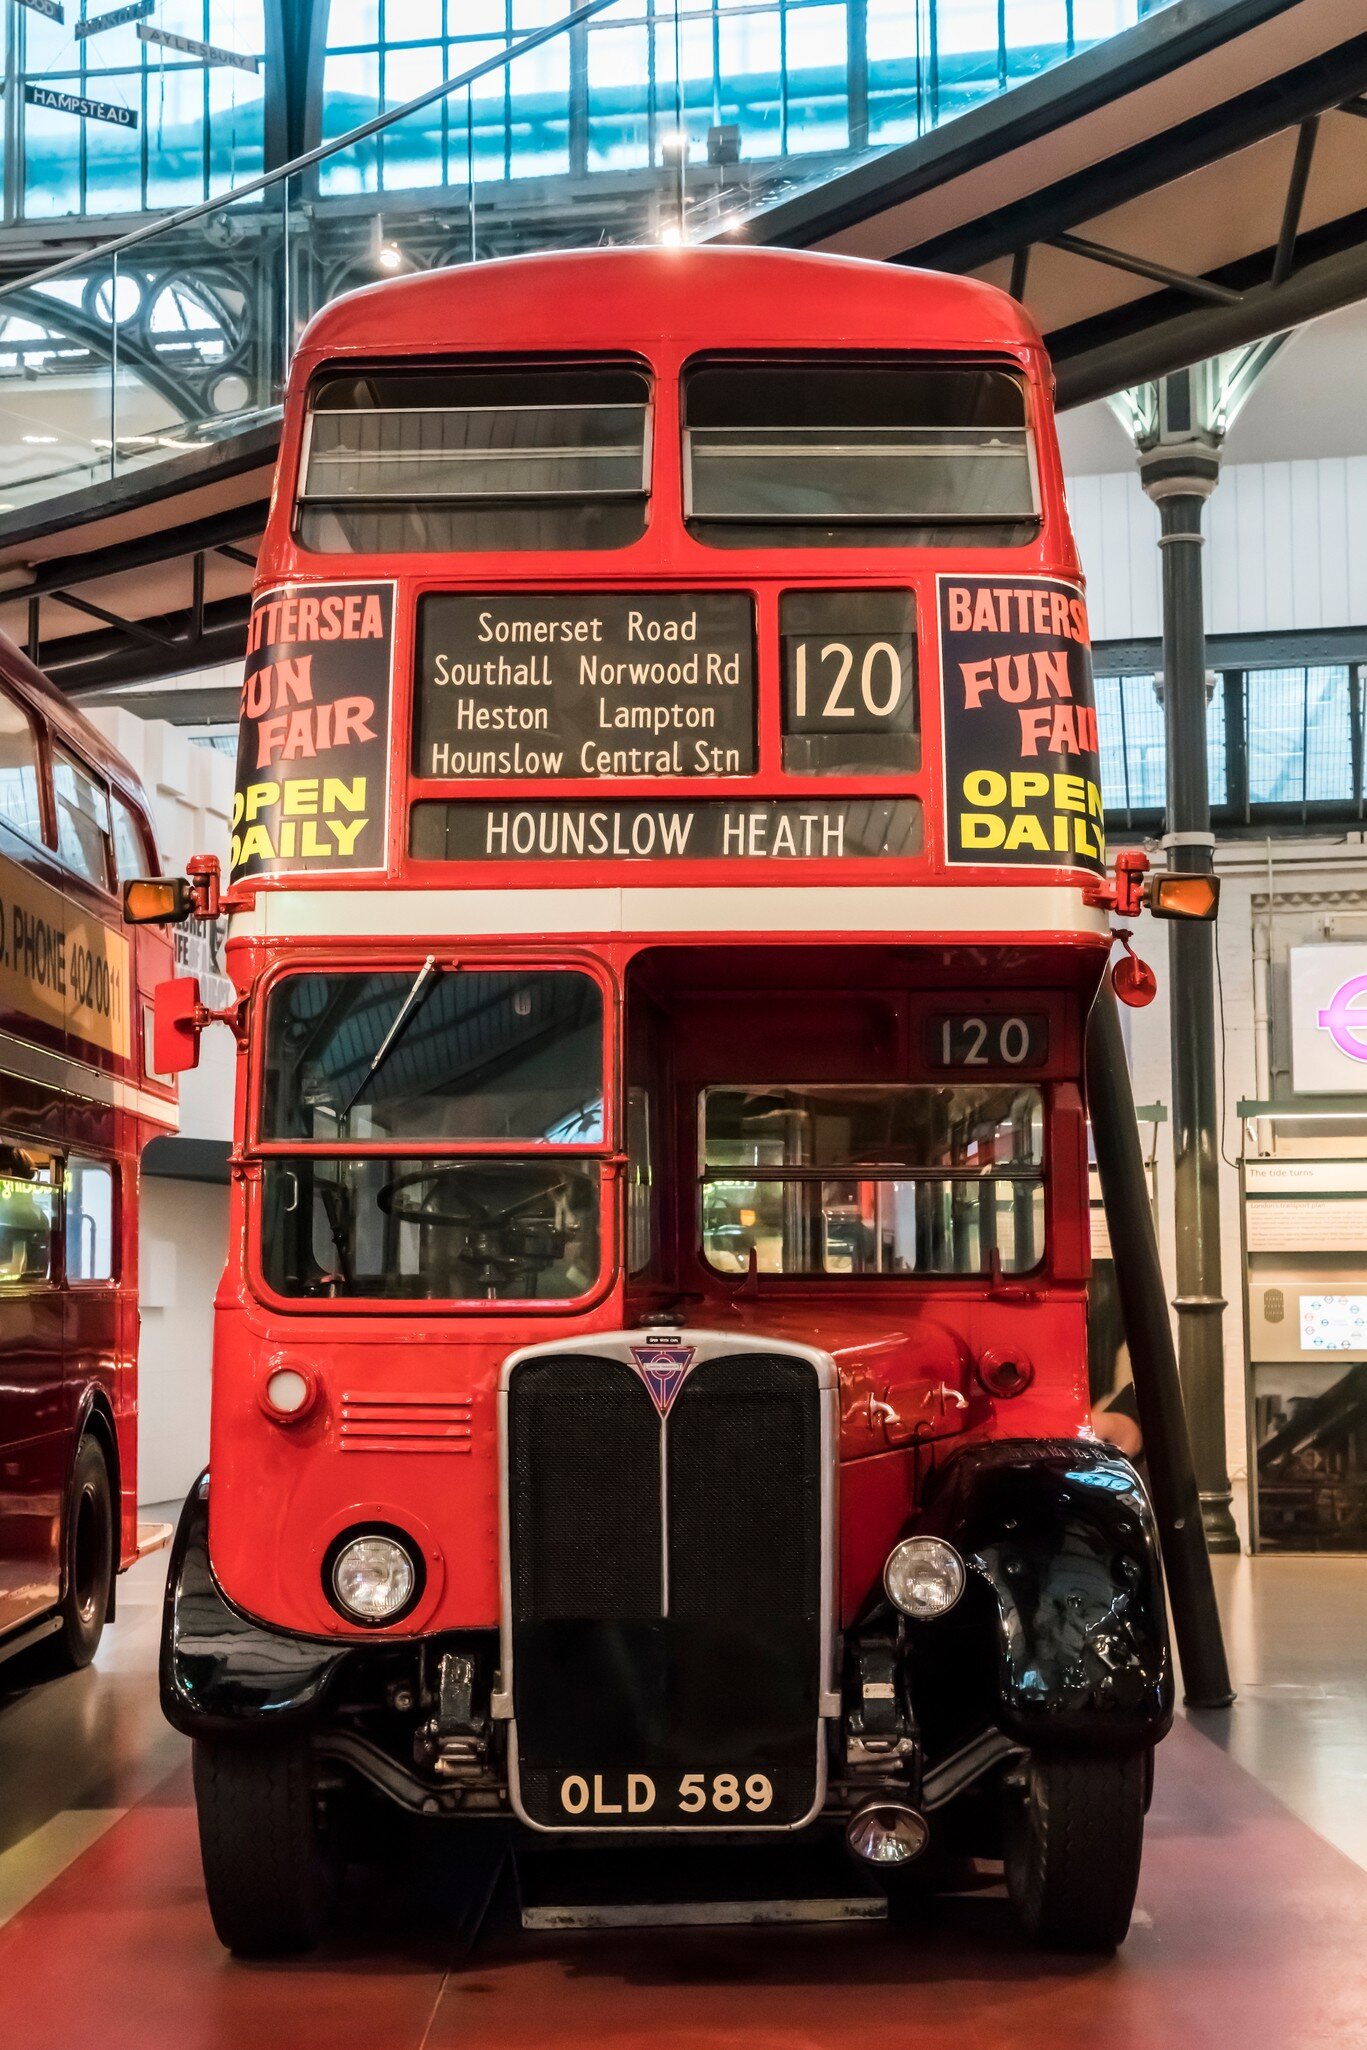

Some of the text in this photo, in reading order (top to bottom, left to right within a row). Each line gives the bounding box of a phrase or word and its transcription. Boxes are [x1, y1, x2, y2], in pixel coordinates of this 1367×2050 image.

[150, 30, 246, 68] AYLESBURY
[33, 88, 131, 125] HAMPSTEAD
[246, 594, 384, 656] TTERSEA
[477, 611, 697, 643] Somerset Road
[948, 587, 1091, 646] BATTERS
[434, 652, 740, 686] Southall Norwood Rd
[796, 641, 902, 717] 120
[958, 650, 1073, 710] FUN
[256, 695, 378, 770] FAIR
[456, 697, 715, 736] Heston Lampton
[431, 740, 740, 774] Hounslow Central Stn
[962, 769, 1105, 826] OPEN
[485, 811, 845, 858] HOUNSLOW HEATH
[960, 813, 1106, 866] DAILY
[13, 904, 66, 996] PHONE
[941, 1018, 1029, 1065] 120
[1250, 1168, 1314, 1177] The tide turns
[560, 1773, 774, 1815] OLD 589
